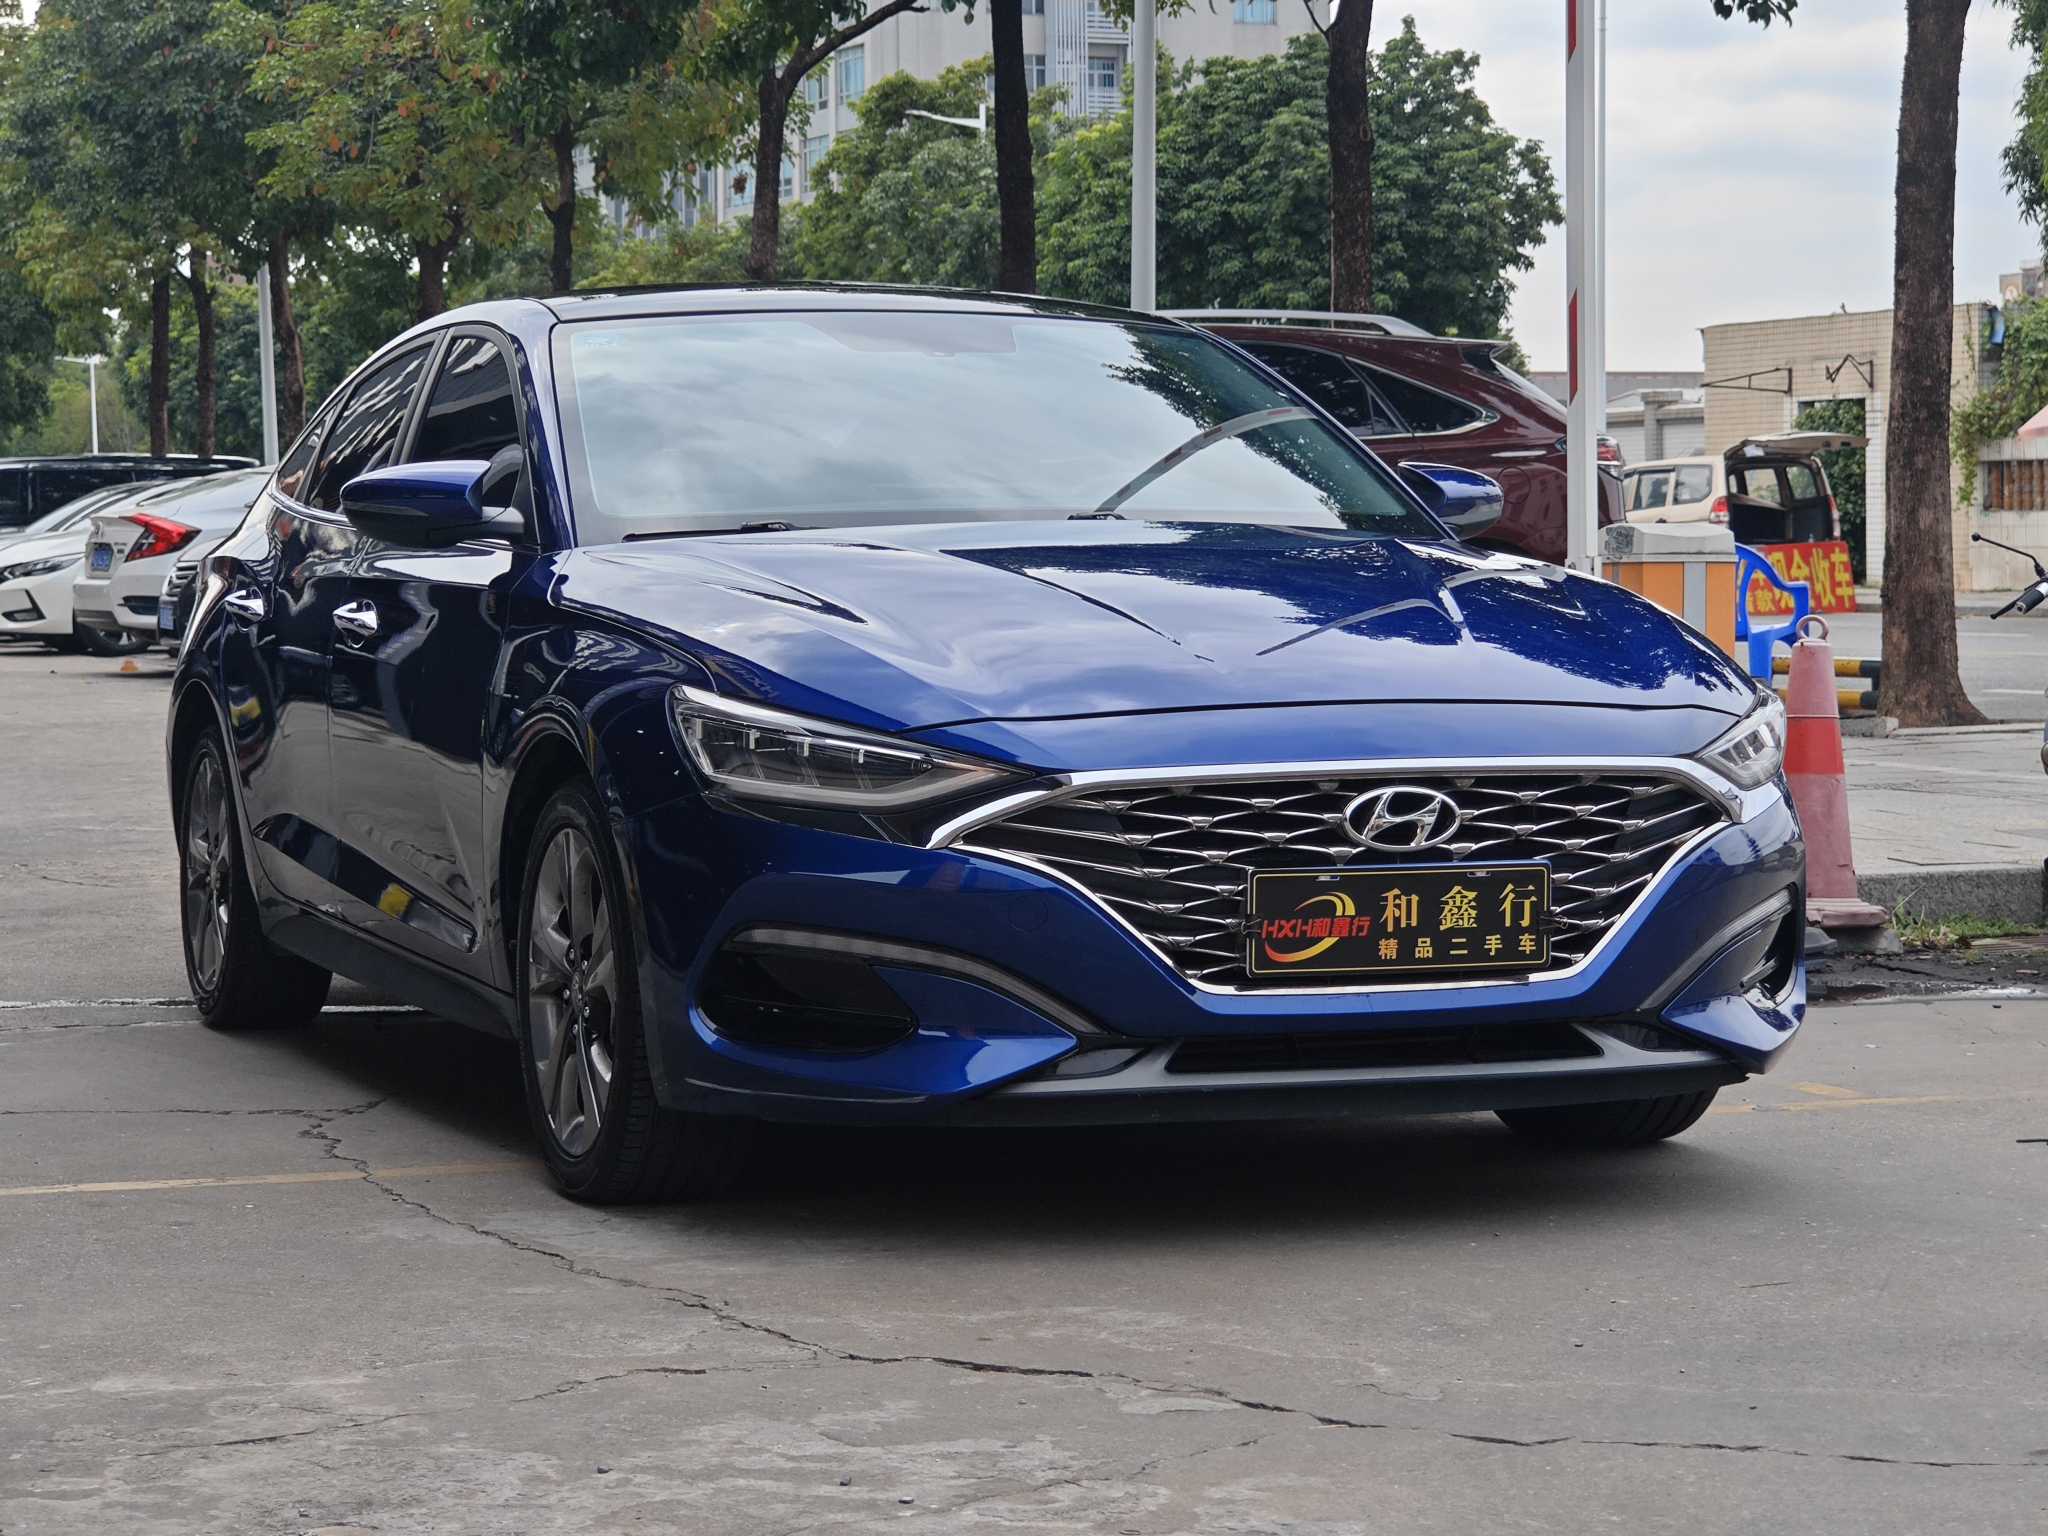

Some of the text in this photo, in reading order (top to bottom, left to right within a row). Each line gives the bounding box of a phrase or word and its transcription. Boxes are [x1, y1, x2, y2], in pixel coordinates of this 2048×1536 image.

[1379, 882, 1538, 933] 和鑫行
[1378, 933, 1537, 960] 精品二手车
